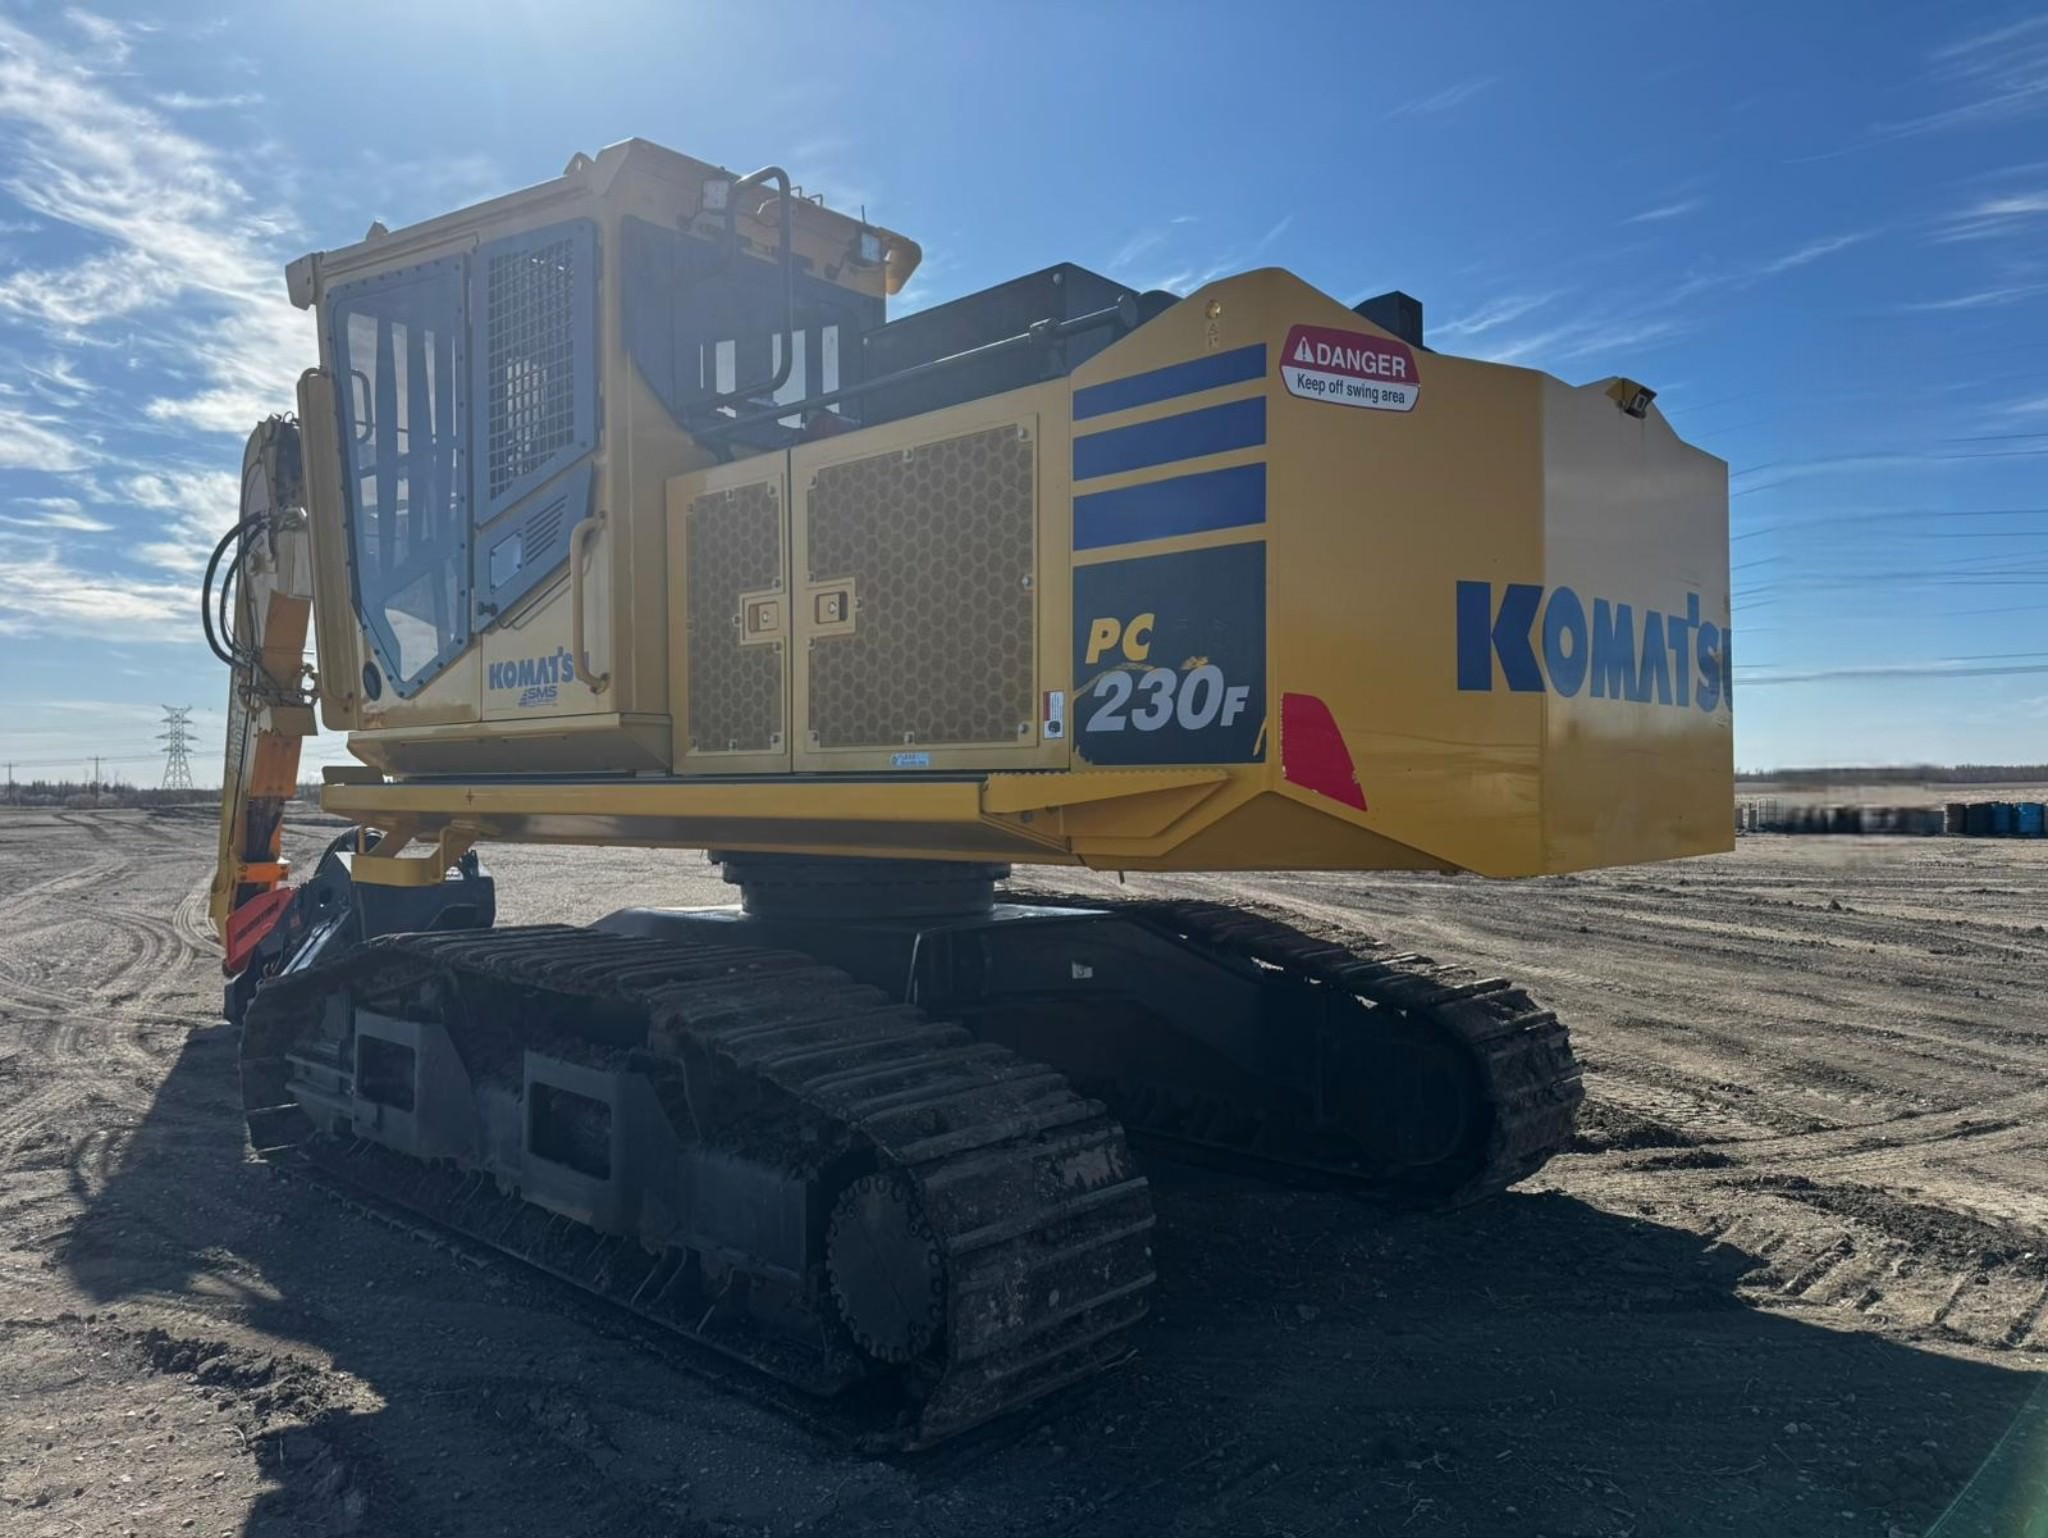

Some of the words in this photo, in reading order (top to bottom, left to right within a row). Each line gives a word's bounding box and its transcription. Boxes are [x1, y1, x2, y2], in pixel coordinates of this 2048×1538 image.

[1316, 343, 1406, 378] DANGER
[1297, 373, 1326, 396] Keep
[1329, 379, 1344, 395] off
[1346, 384, 1379, 403] swing
[1381, 390, 1405, 404] area
[1085, 612, 1155, 665] PC
[527, 685, 558, 699] SMS
[1086, 664, 1250, 732] 230F
